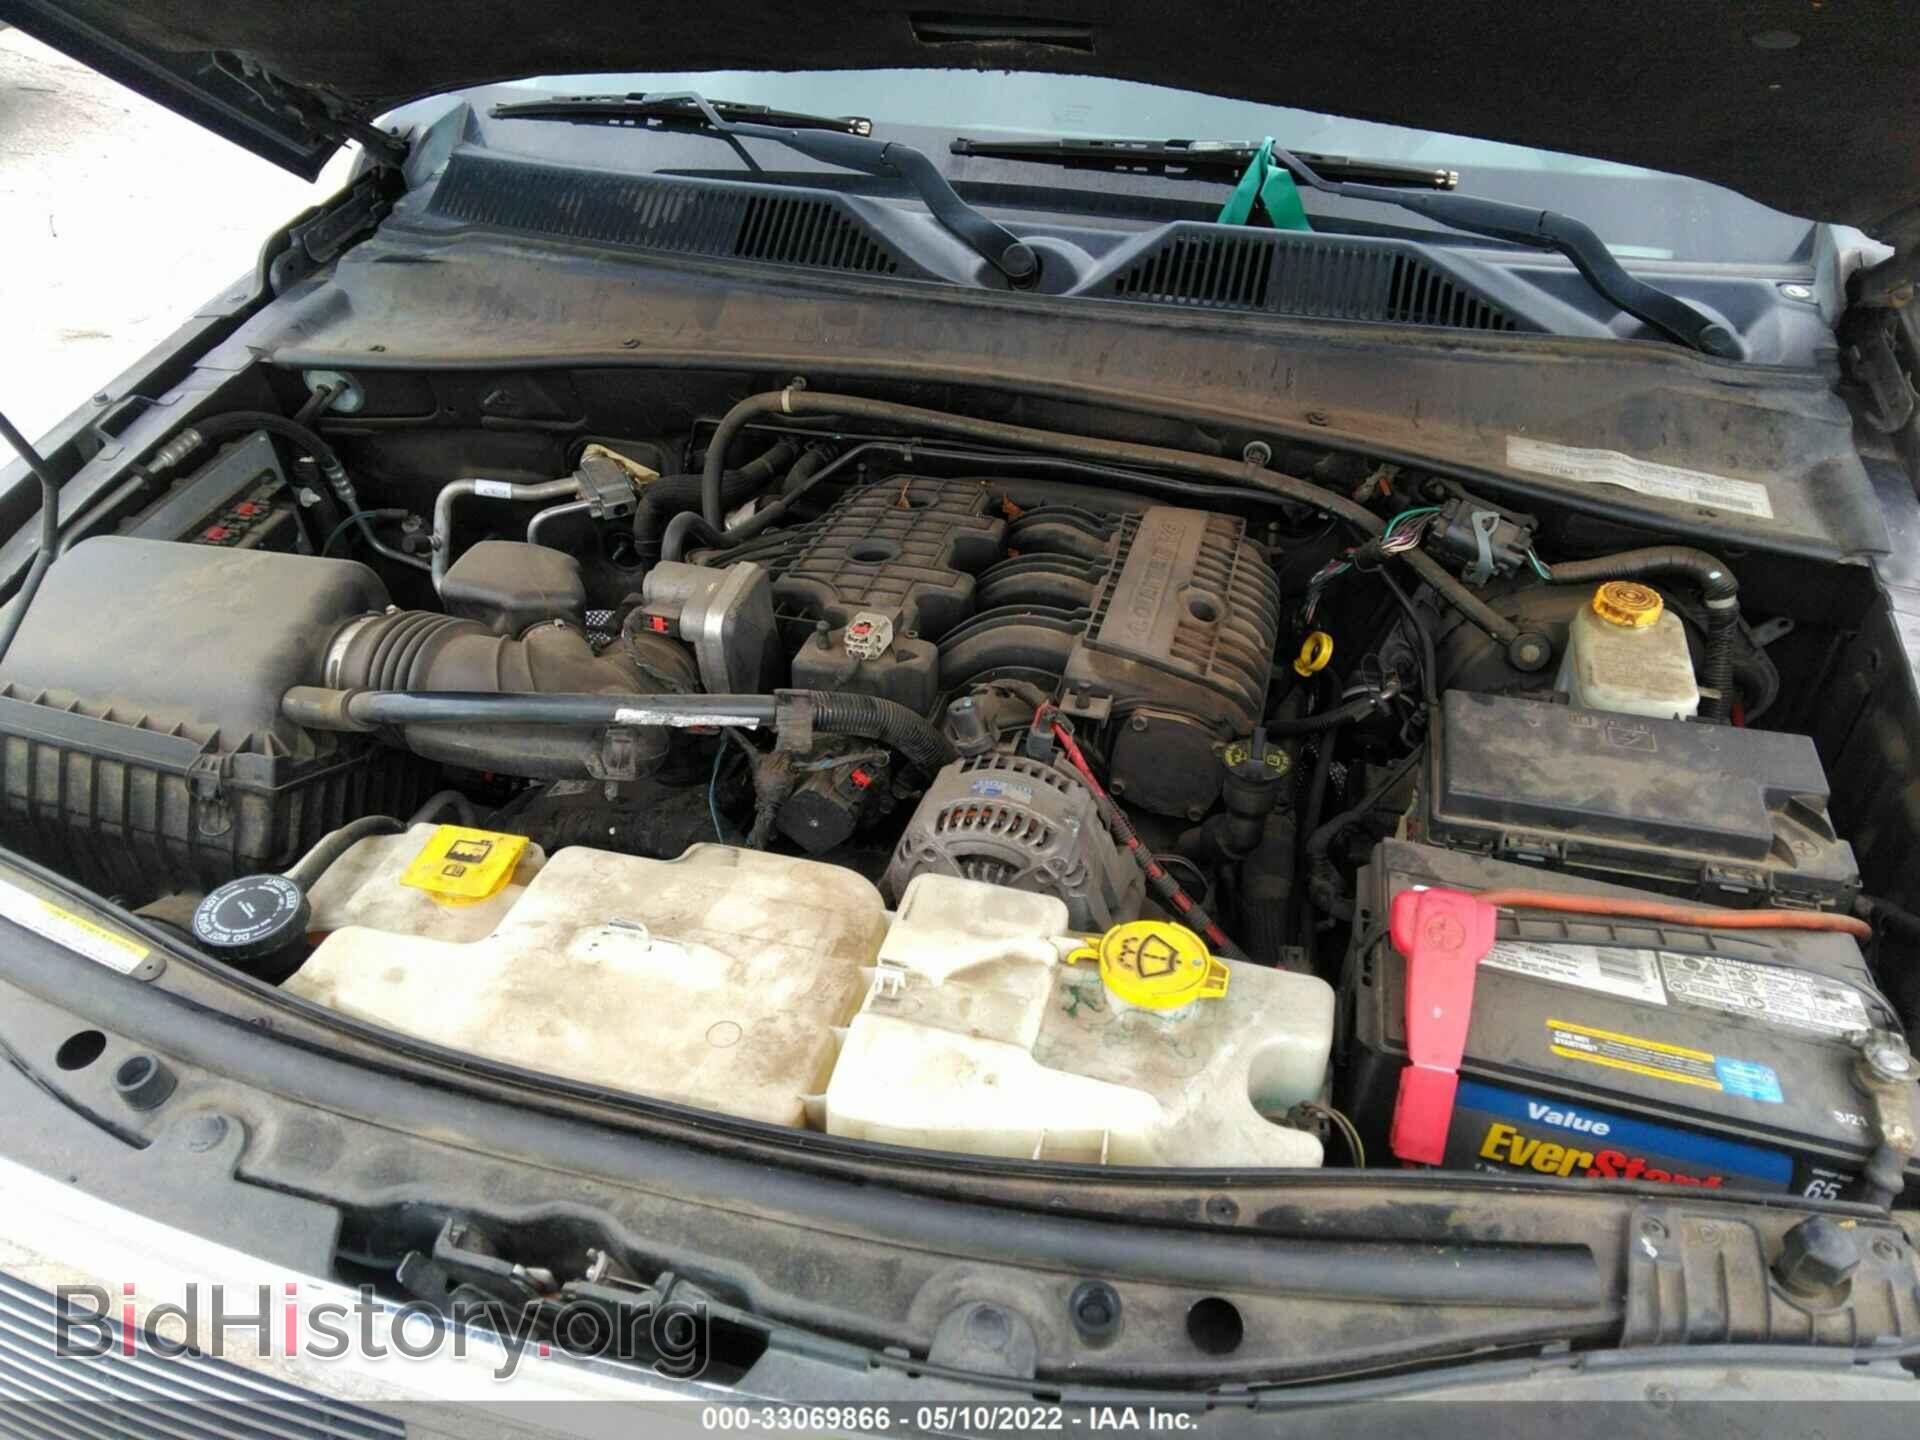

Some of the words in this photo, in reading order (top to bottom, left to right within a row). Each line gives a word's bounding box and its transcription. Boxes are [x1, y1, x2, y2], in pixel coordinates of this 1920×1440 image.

[198, 912, 212, 934] OPEN
[207, 930, 232, 943] NOT
[233, 932, 250, 943] DO
[1528, 1102, 1610, 1136] Value
[1804, 1179, 1842, 1200] 65
